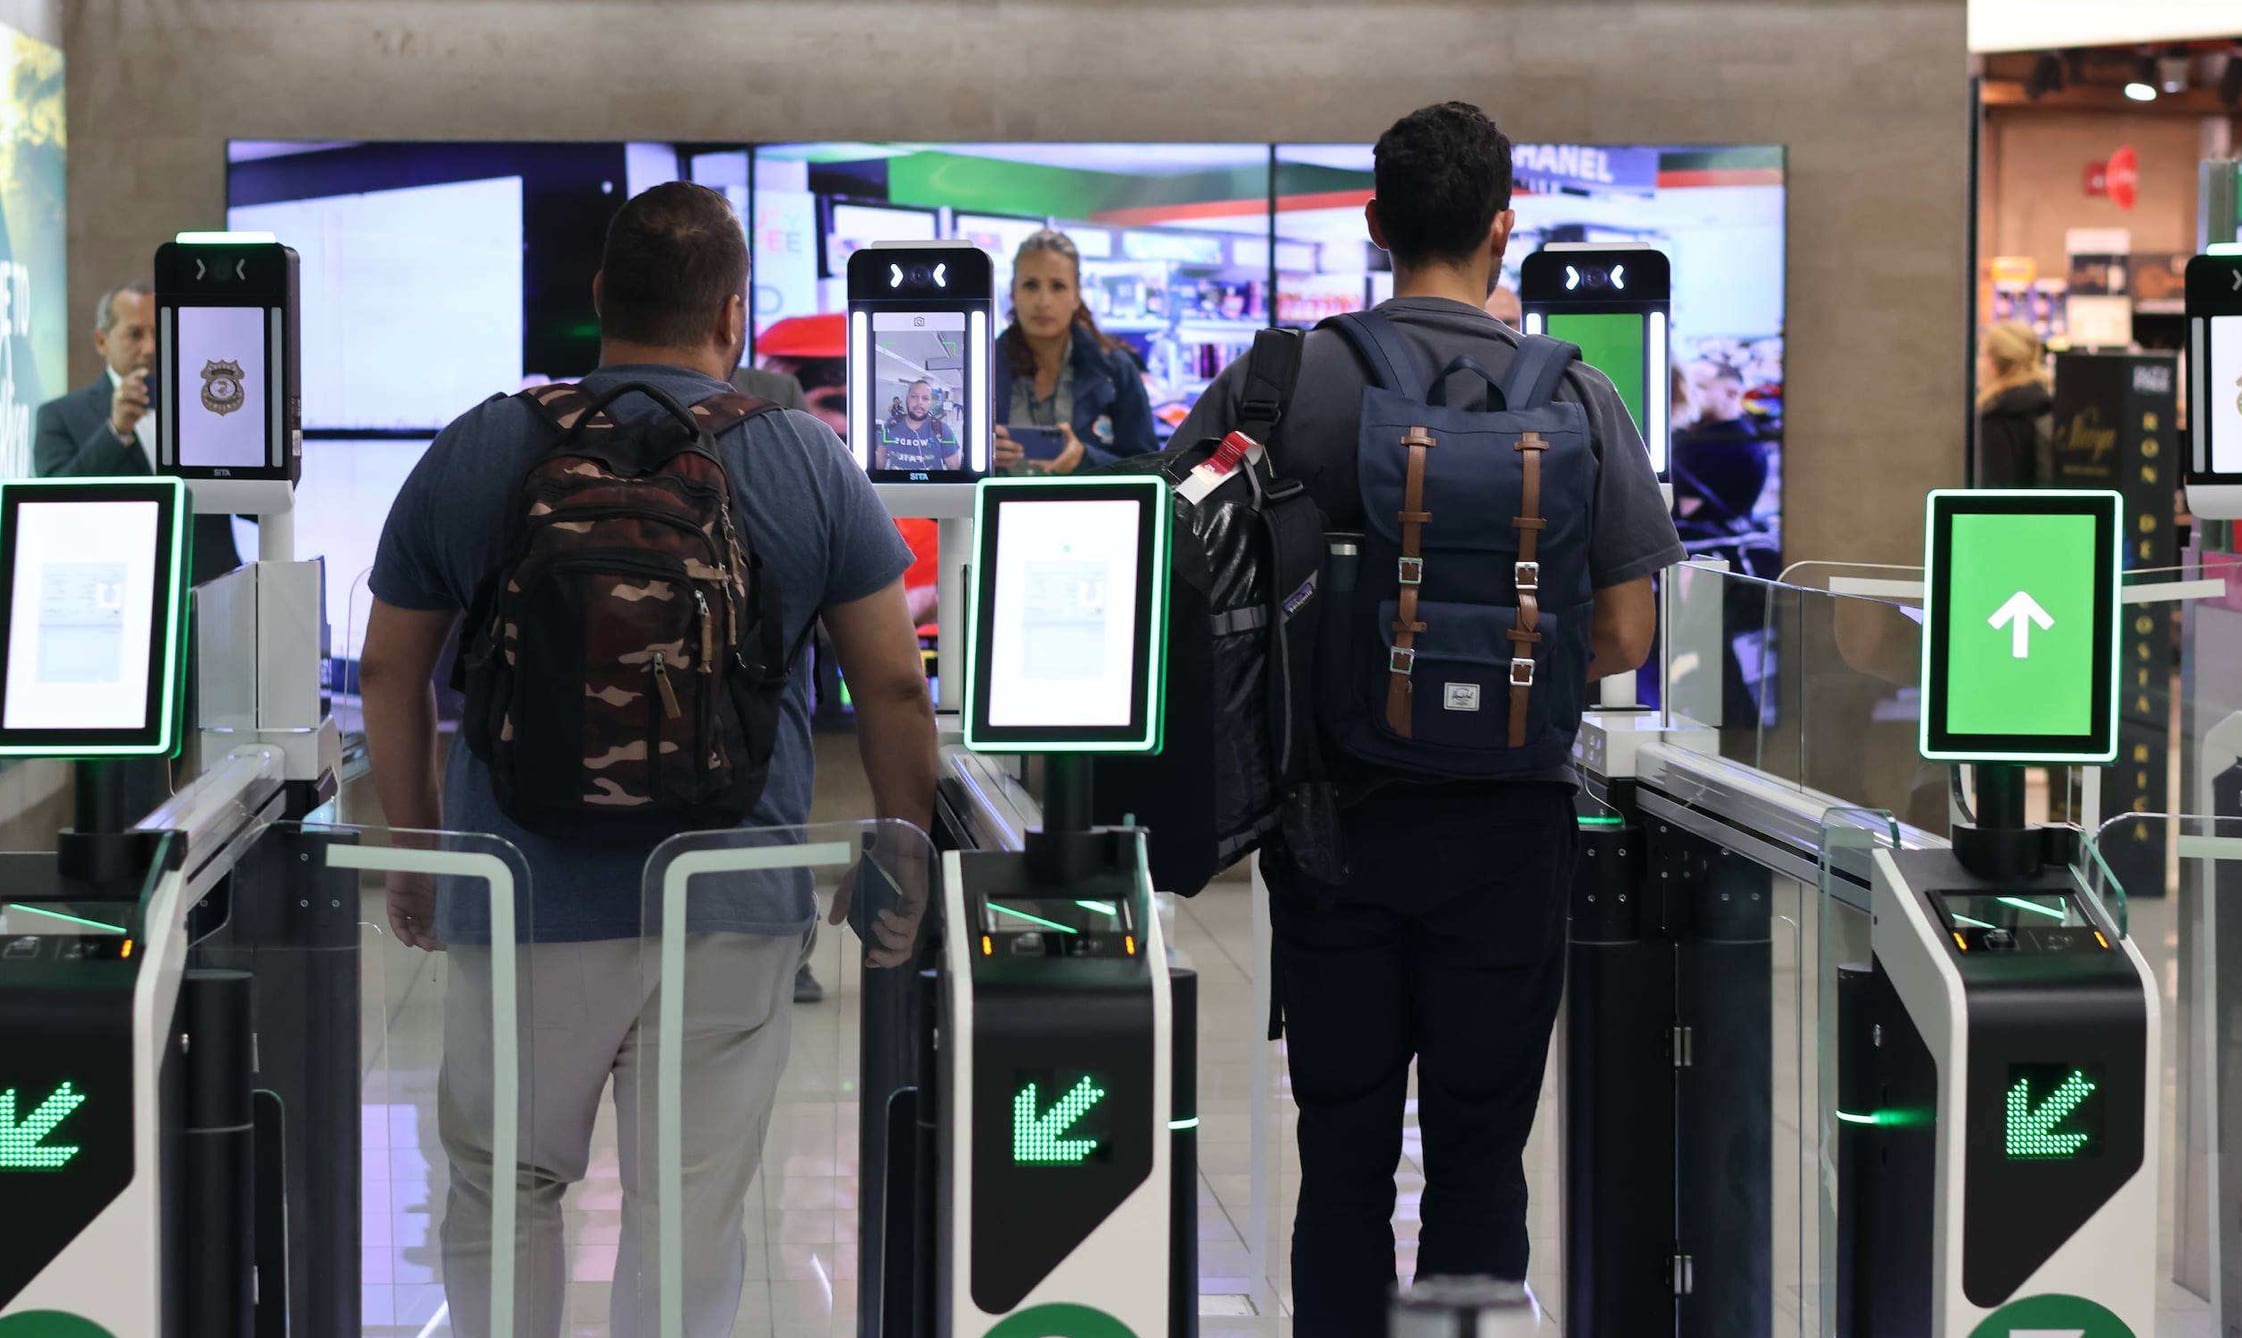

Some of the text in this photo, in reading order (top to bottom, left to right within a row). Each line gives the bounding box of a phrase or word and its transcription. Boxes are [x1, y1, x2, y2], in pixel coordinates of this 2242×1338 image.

[1511, 143, 1615, 184] HANEL
[213, 468, 231, 477] SITA
[909, 472, 929, 481] SITA
[2135, 602, 2153, 712] OSTA
